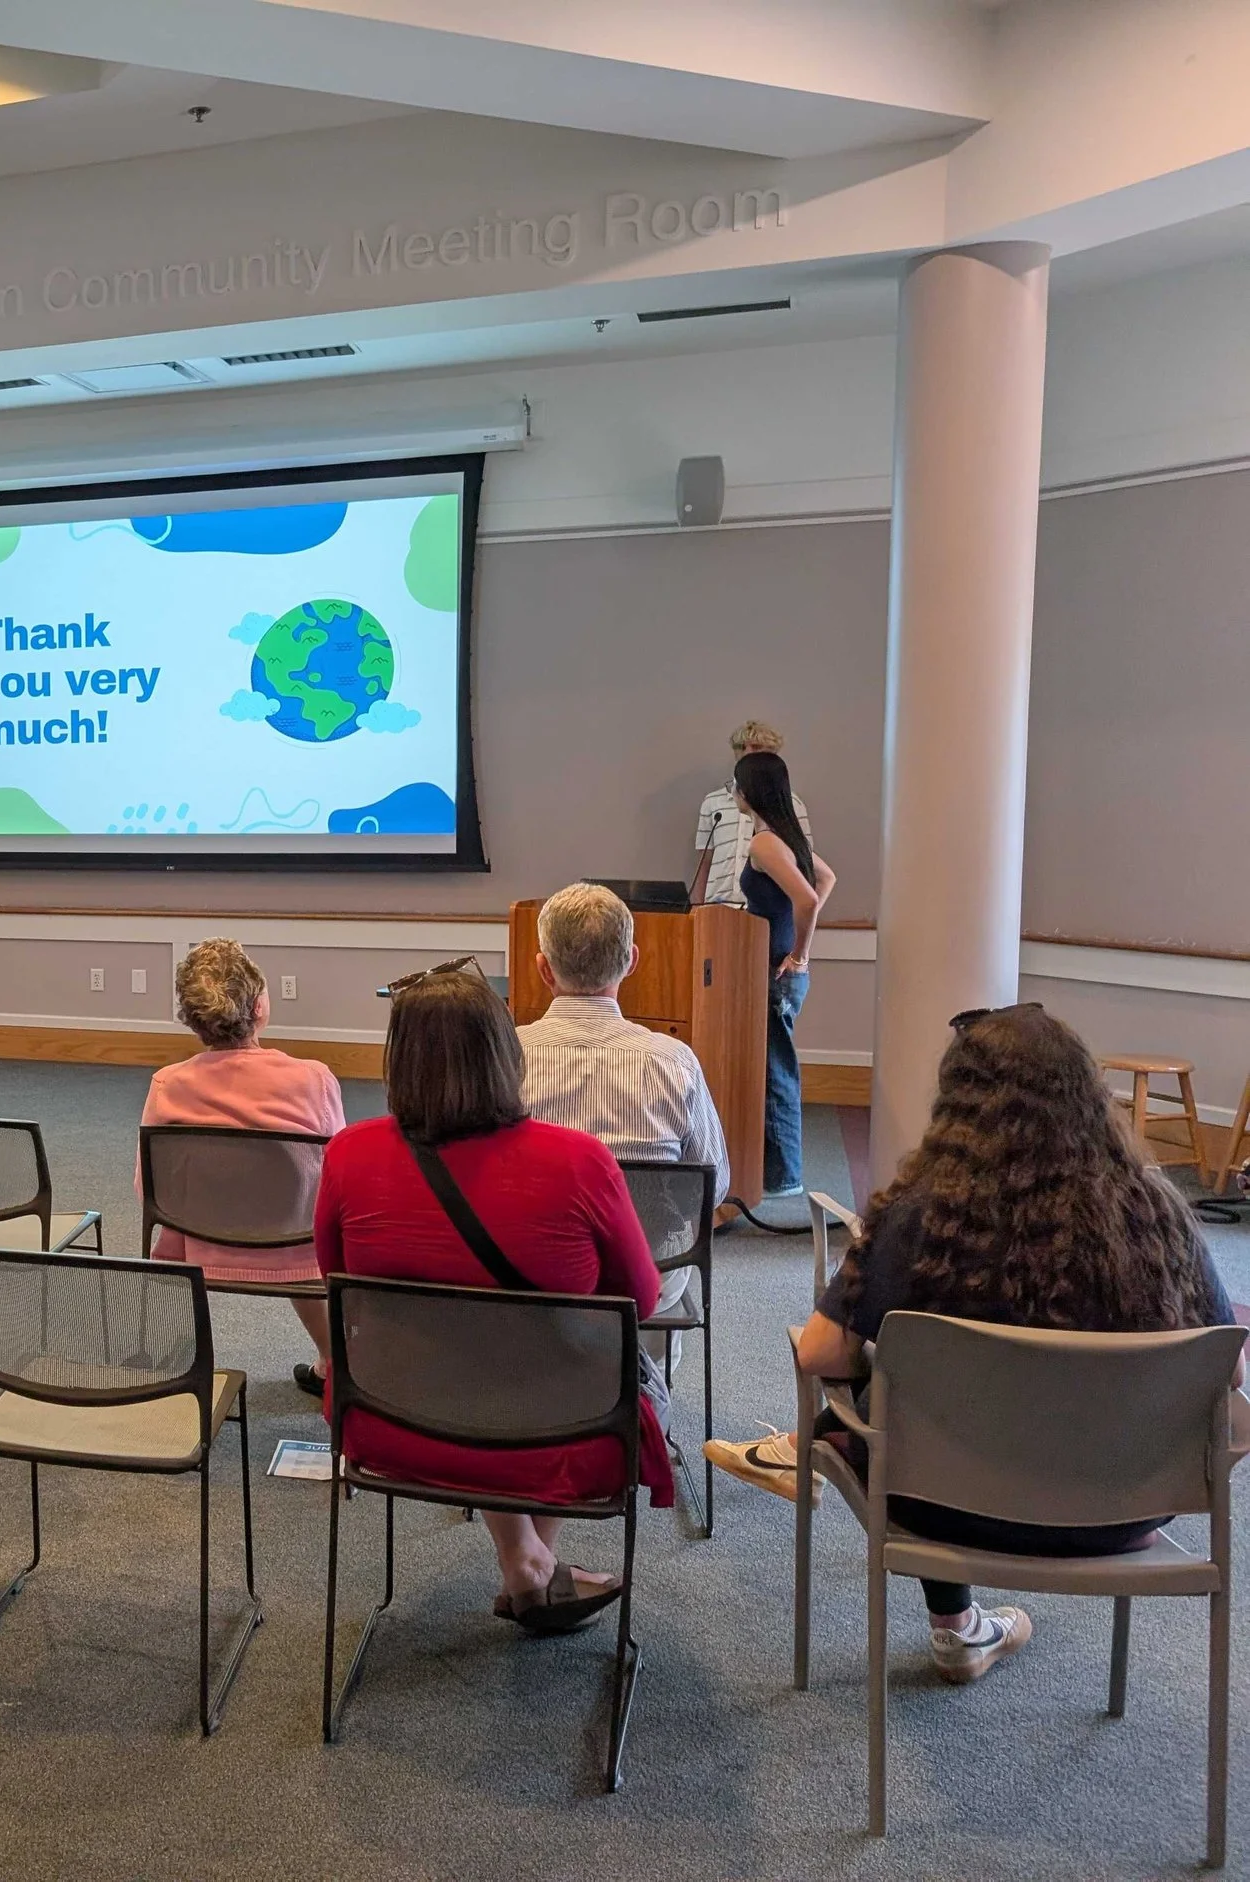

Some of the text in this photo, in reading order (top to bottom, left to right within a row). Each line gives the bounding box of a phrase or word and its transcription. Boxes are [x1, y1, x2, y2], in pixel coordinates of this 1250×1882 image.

[42, 238, 332, 313] Community
[351, 209, 578, 277] Meeting
[605, 186, 789, 247] Room
[65, 667, 161, 702] very
